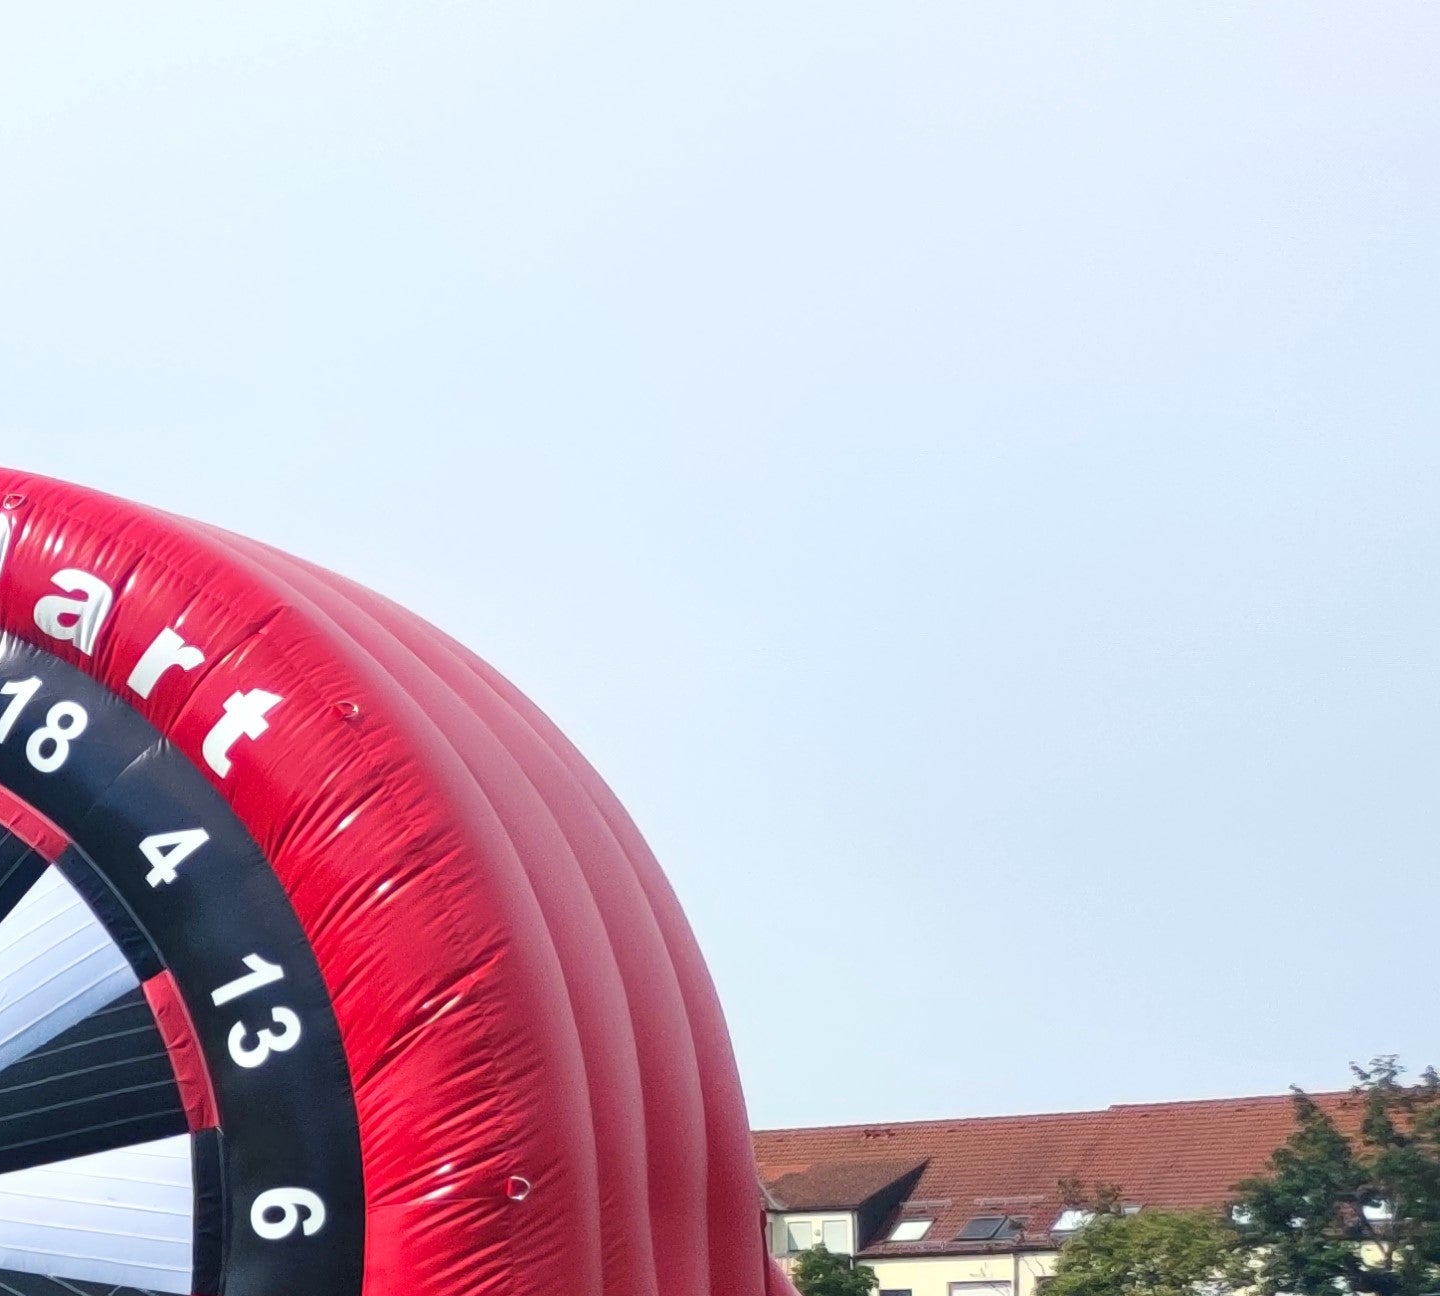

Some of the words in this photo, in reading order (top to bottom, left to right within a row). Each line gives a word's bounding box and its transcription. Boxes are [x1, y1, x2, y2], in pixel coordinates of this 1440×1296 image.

[0, 676, 88, 773] 18
[138, 827, 210, 888] 4
[211, 953, 302, 1069] 13
[250, 1187, 326, 1240] 6
